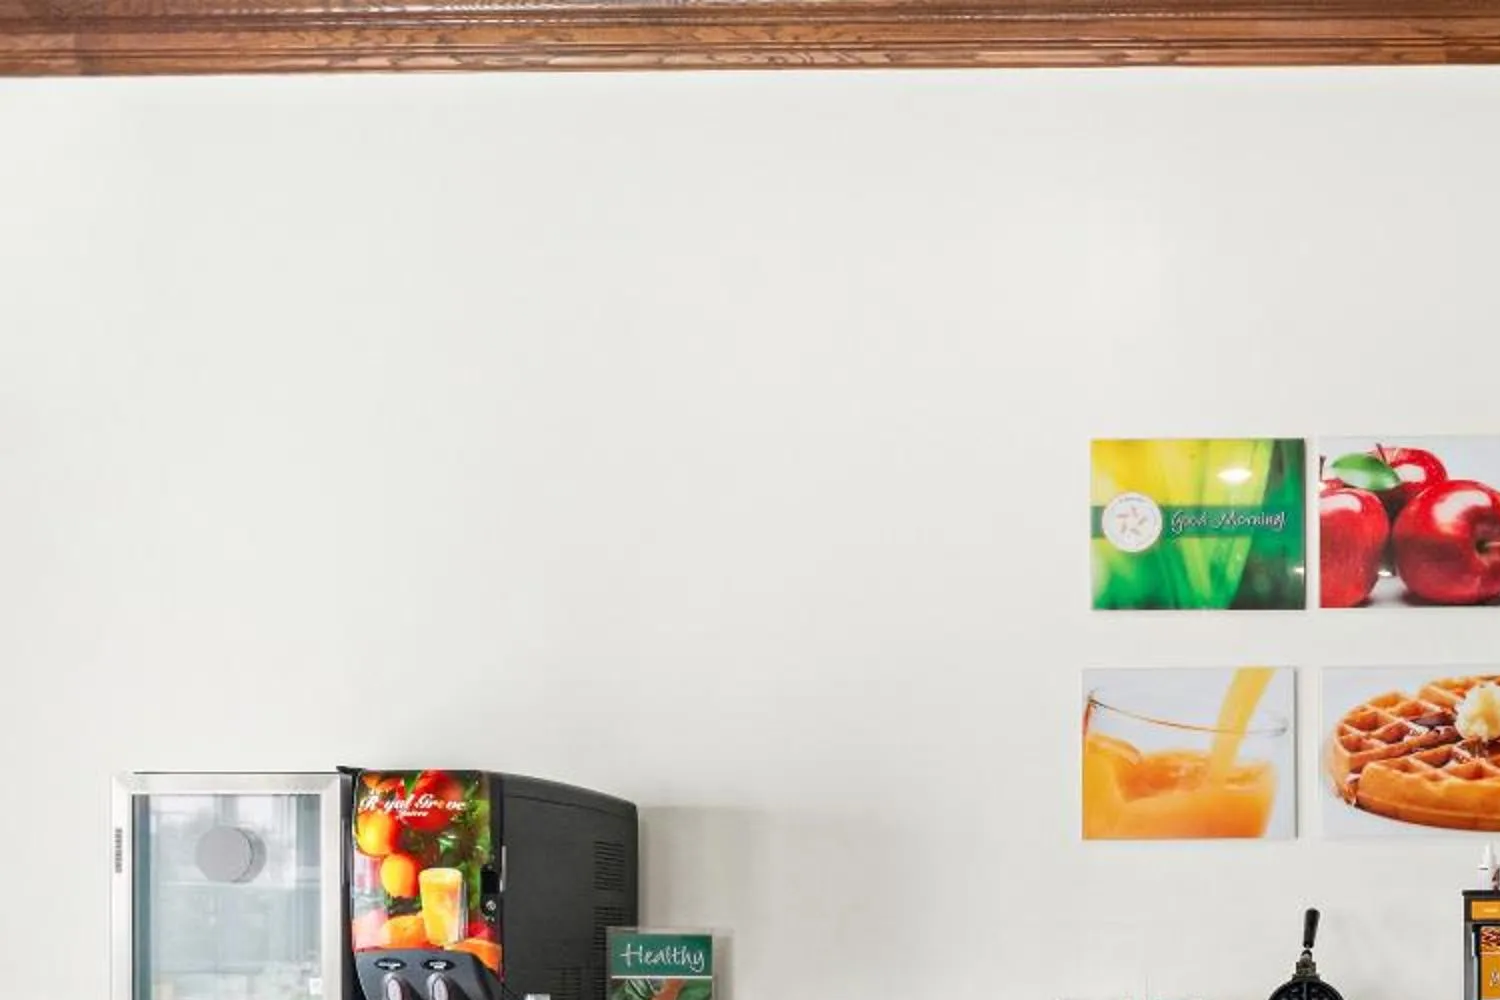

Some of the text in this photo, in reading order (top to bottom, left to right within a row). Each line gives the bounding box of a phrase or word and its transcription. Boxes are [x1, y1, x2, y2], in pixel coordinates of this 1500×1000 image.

[1170, 510, 1287, 535] Good Morning!
[620, 943, 705, 973] Healthy
